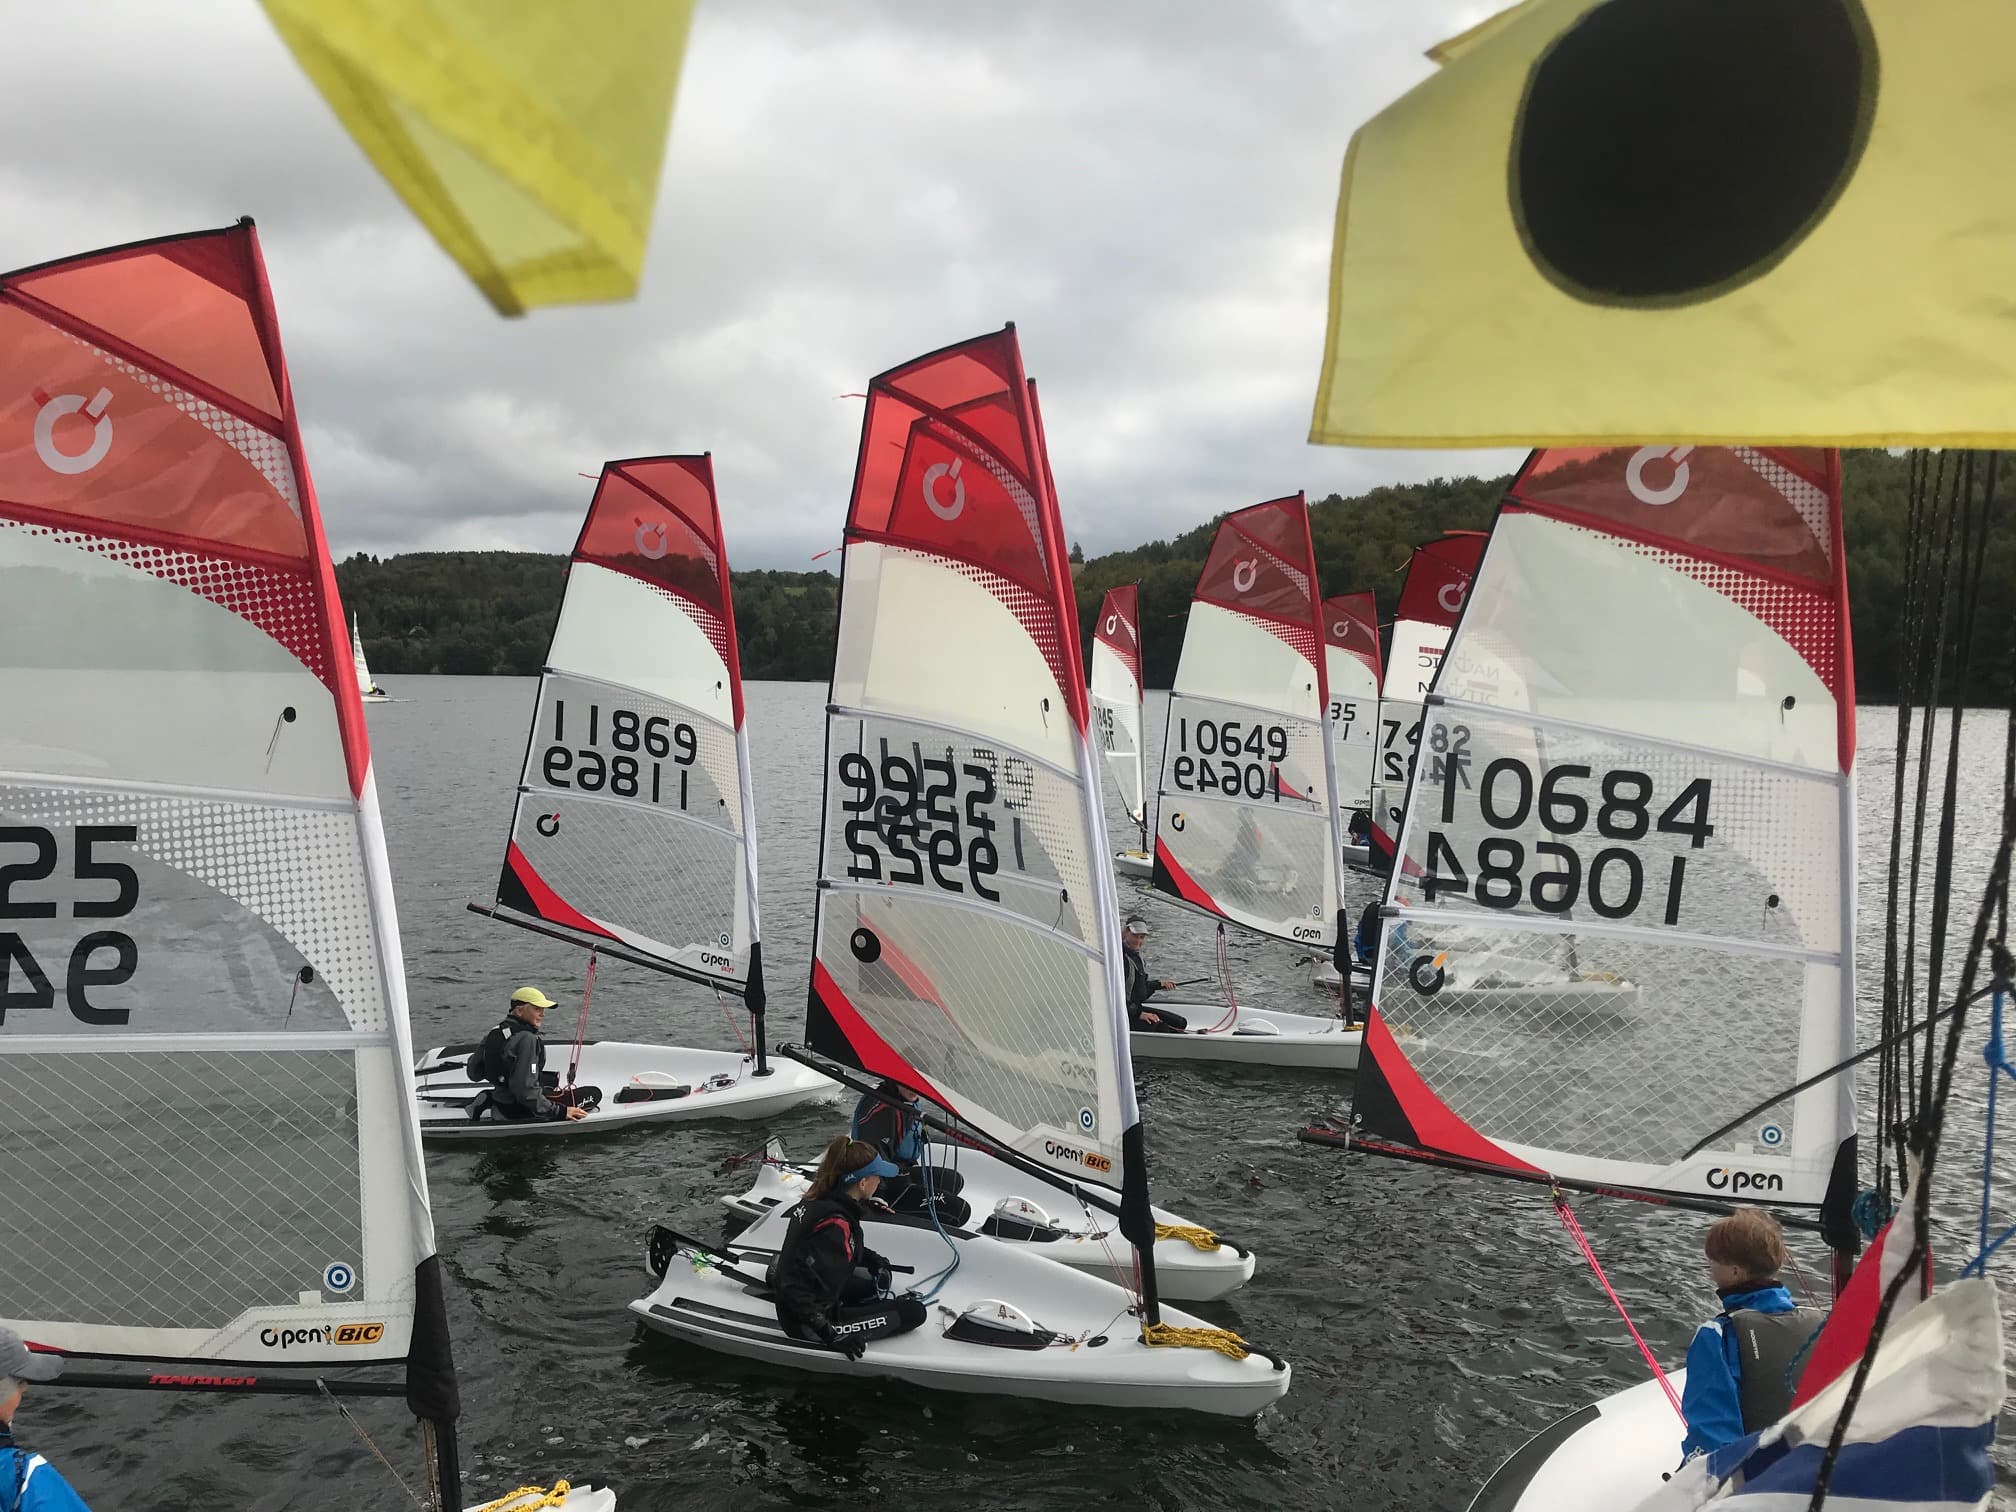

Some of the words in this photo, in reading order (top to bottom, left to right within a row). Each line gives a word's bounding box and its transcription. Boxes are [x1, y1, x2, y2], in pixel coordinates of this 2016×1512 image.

[555, 700, 697, 765] 11869
[1180, 718, 1287, 762] 10649
[1441, 752, 1714, 849] 10684
[0, 825, 140, 919] 25
[1706, 1167, 1784, 1194] Open
[831, 1315, 887, 1335] OOSTER
